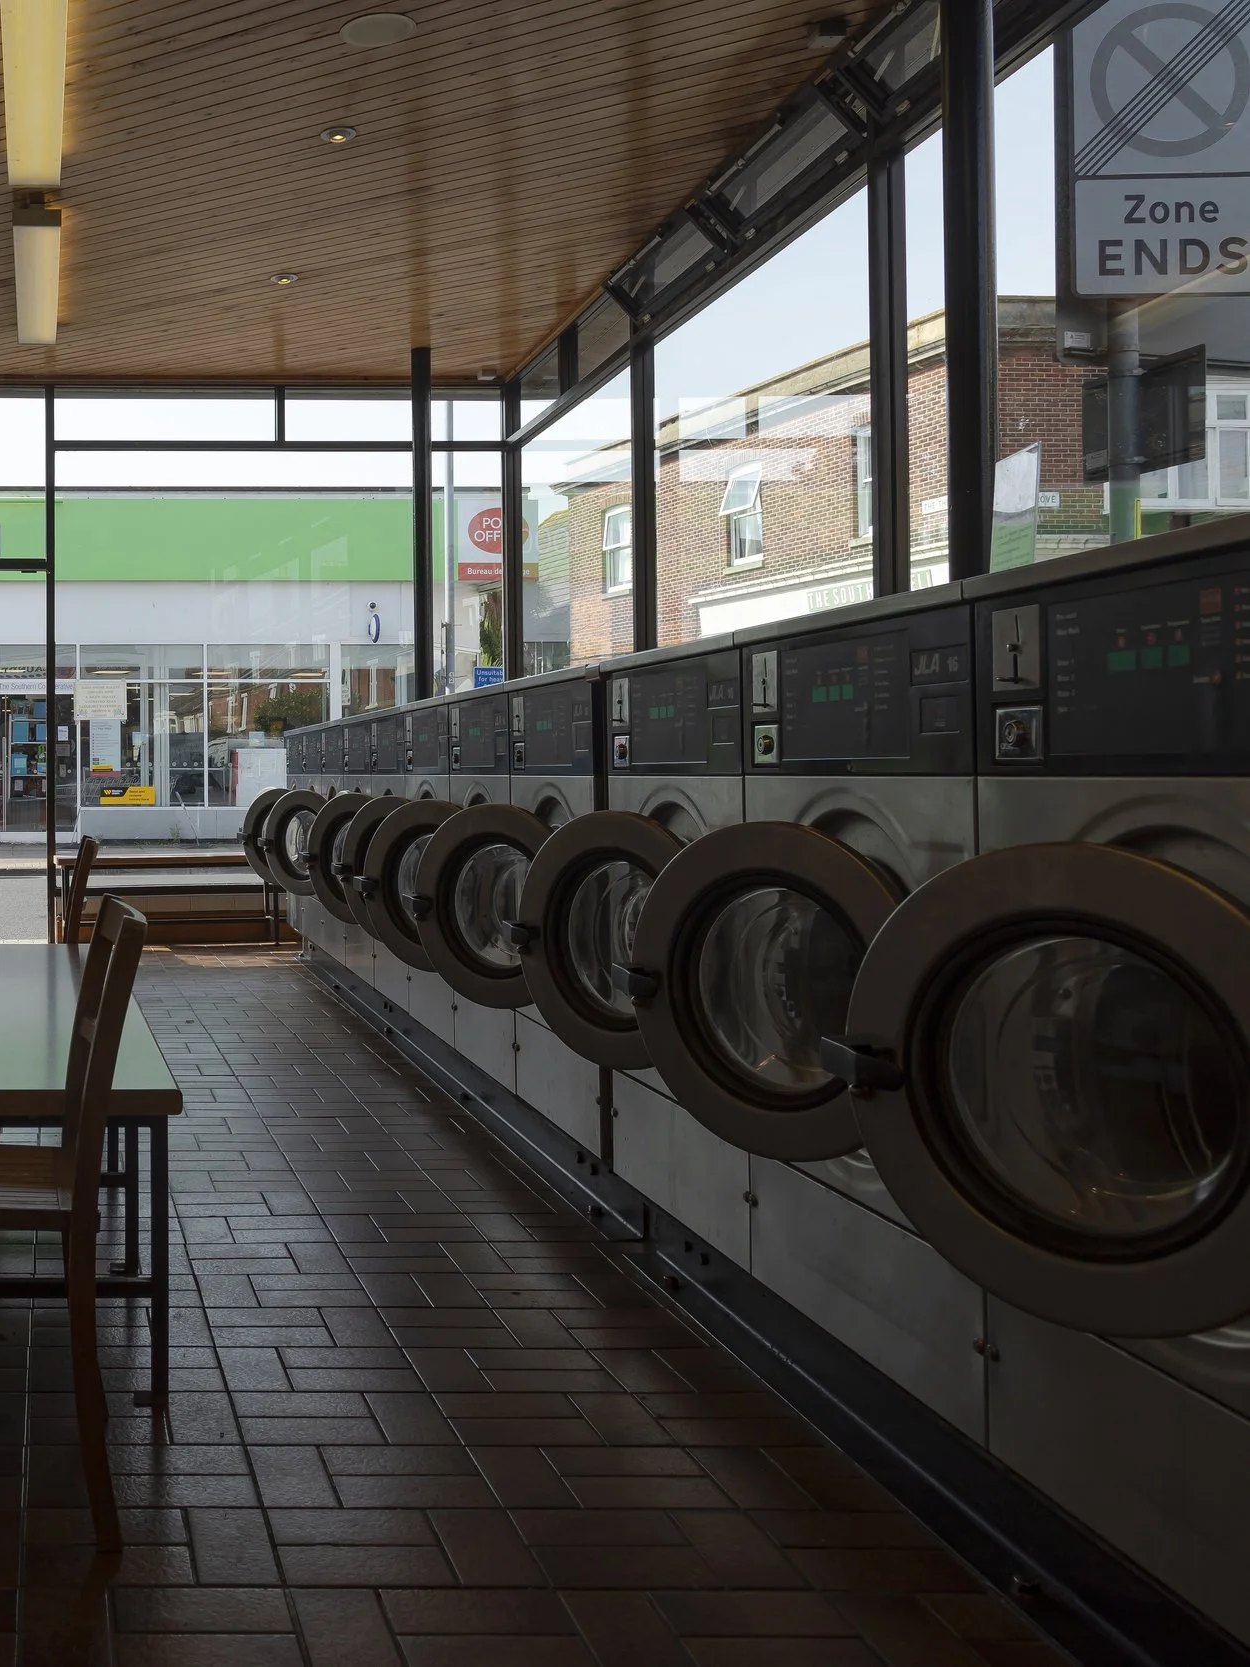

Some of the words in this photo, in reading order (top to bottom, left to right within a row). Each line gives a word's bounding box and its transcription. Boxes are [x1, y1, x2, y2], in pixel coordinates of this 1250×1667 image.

[1124, 194, 1220, 224] Zone
[1098, 236, 1248, 276] ENDS
[482, 517, 502, 529] PO
[474, 530, 501, 542] OFF
[467, 567, 492, 575] Bureau
[808, 589, 831, 609] THE
[832, 582, 874, 606] SOUTH
[914, 653, 940, 676] JLA
[489, 676, 503, 684] heav
[0, 683, 10, 691] The
[11, 682, 37, 691] Southern
